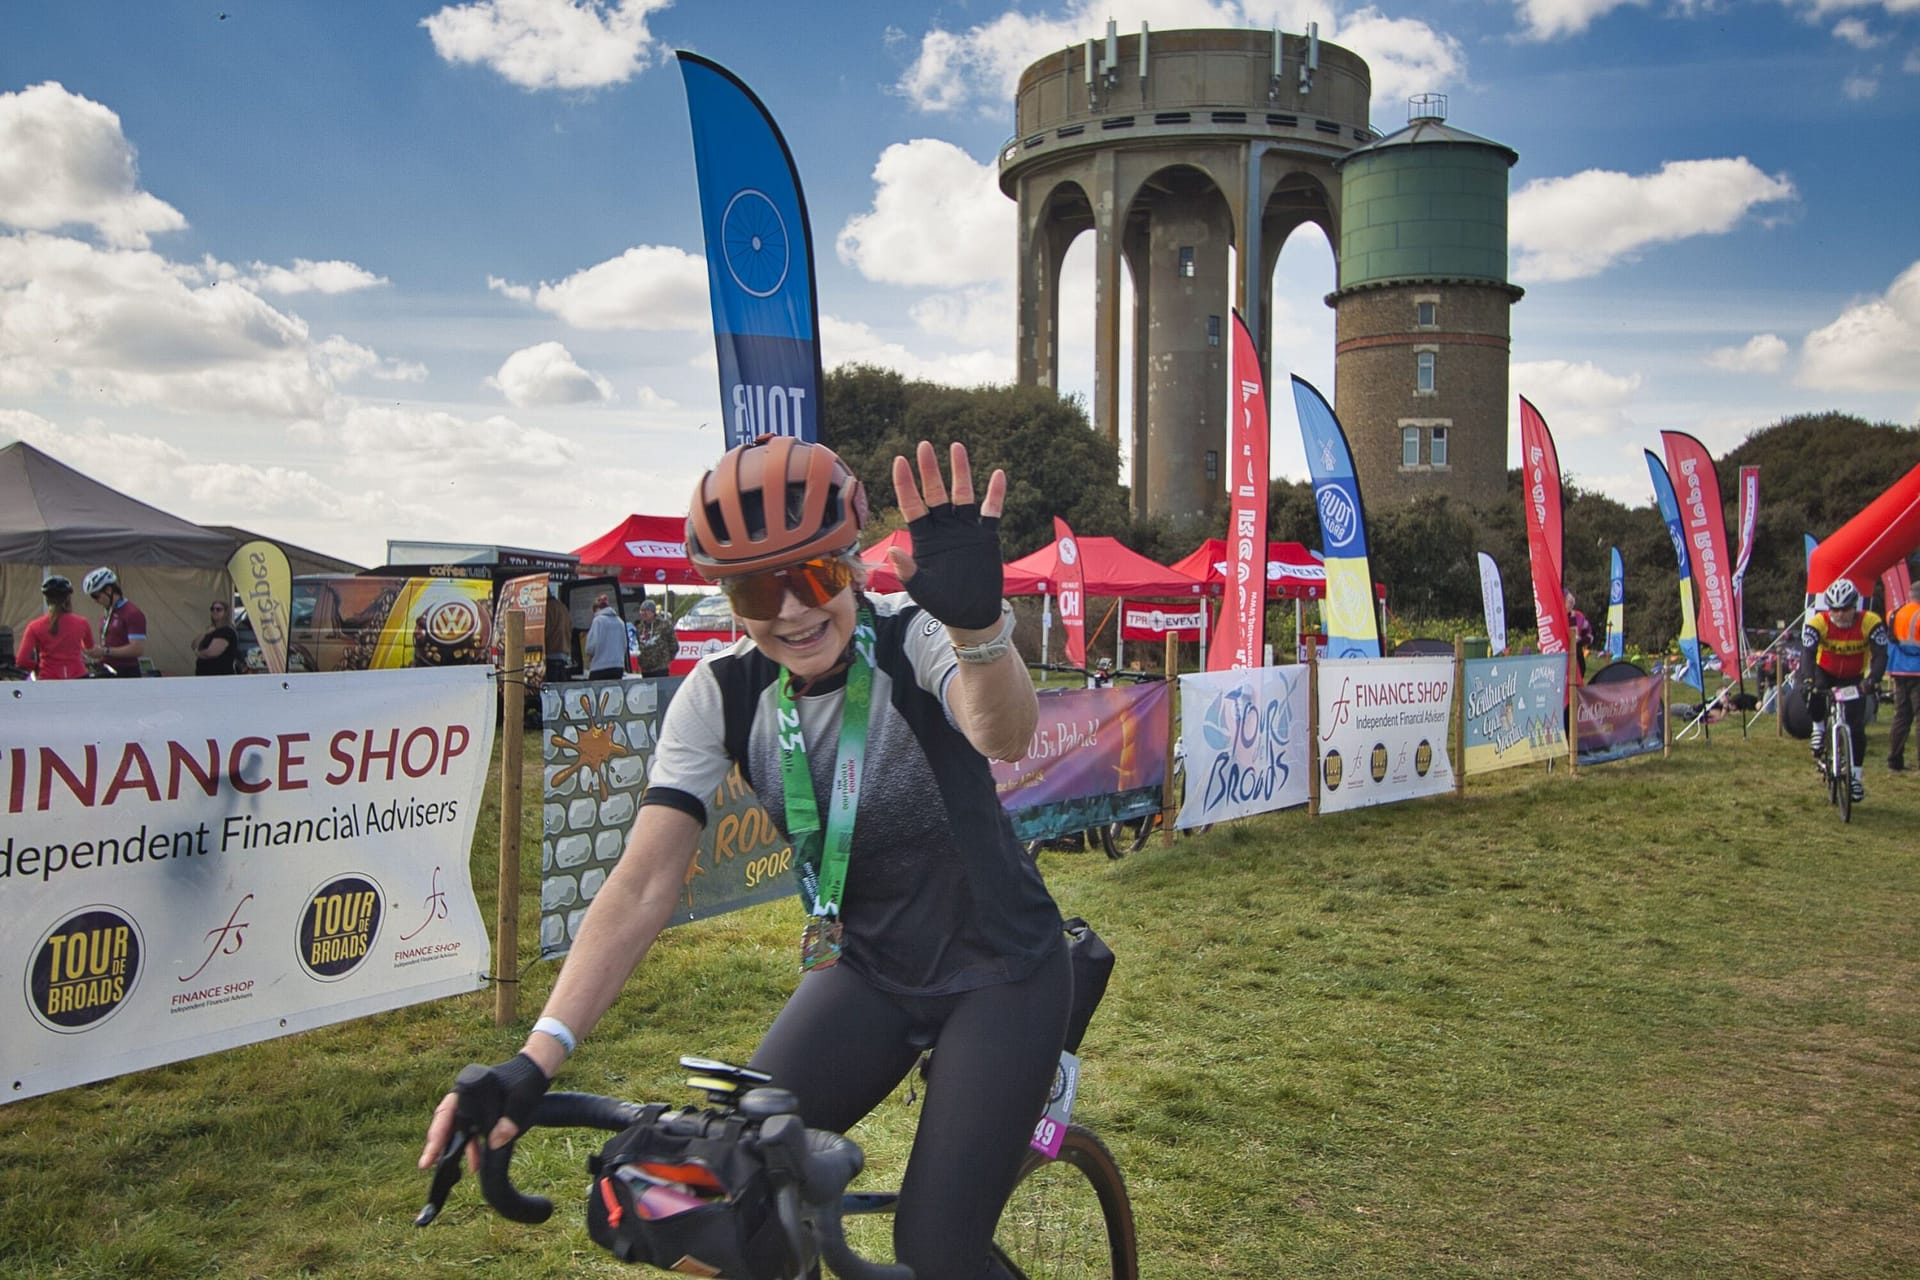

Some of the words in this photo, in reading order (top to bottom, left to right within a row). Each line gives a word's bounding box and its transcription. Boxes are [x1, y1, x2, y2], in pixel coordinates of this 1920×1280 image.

[1355, 682, 1415, 708] FINANCE
[1418, 681, 1448, 703] SHOP
[1356, 713, 1399, 731] Independent
[0, 733, 311, 813] INANCE
[325, 725, 470, 785] SHOP
[221, 804, 360, 853] Financial
[366, 797, 459, 836] Advisers
[313, 891, 375, 937] TOUR
[358, 918, 370, 933] DE
[48, 926, 129, 982] TOUR
[311, 933, 368, 965] BROADS
[394, 945, 433, 961] FINANCE
[434, 942, 461, 953] SHOP
[112, 958, 127, 976] DE
[47, 976, 124, 1015] BROADS
[171, 986, 221, 1005] FINANCE
[223, 980, 254, 995] SHOP
